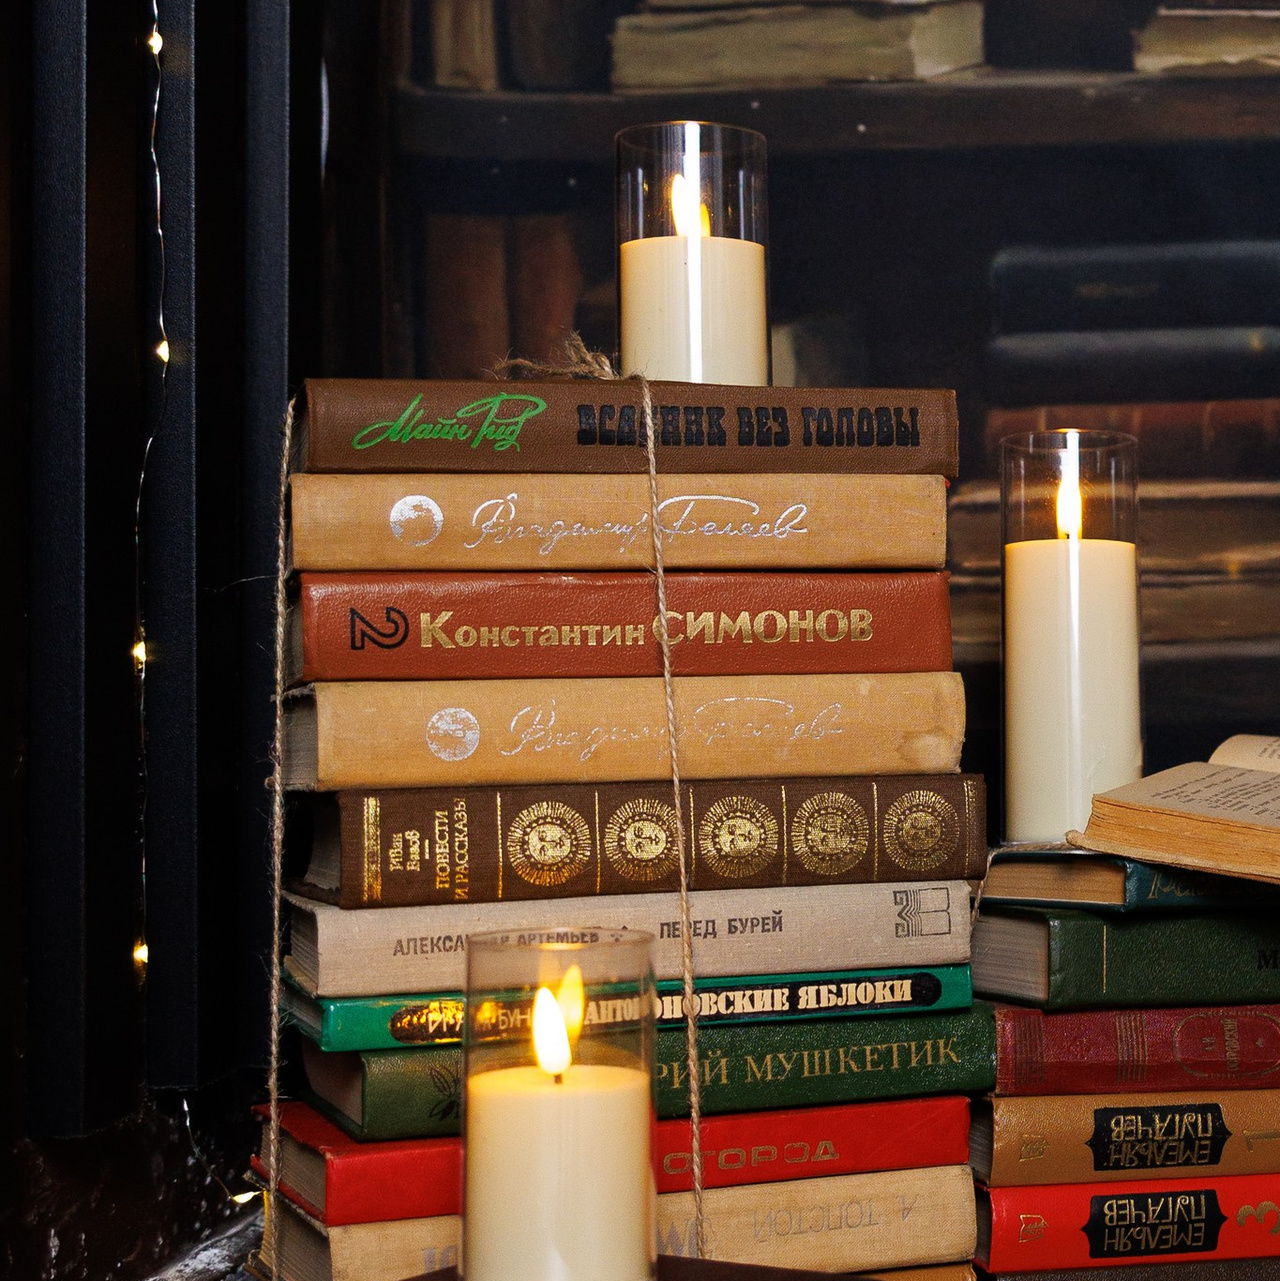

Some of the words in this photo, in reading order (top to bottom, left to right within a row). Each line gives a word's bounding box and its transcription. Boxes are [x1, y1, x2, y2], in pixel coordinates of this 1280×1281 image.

[352, 393, 471, 450] Майн
[456, 391, 547, 452] Рид
[738, 406, 791, 446] БЕЗ
[801, 406, 920, 447] ГОЛОВЫ
[420, 611, 645, 650] Константин
[653, 608, 874, 646] СИМОНОВ
[434, 809, 451, 890] ПОВЕСТИ
[453, 797, 470, 884] РАССКАЗЫ
[659, 918, 718, 940] ПЕРЕД
[727, 909, 785, 936] БУРЕЙ
[797, 979, 913, 1011] ЯБЛОКИ
[656, 1052, 729, 1089] РИЙ
[745, 1037, 961, 1083] МУШКЕТИК
[1103, 1194, 1207, 1226] ПУГАЧЕВ
[1103, 1222, 1205, 1252] ЕМЕЛЬЯН
